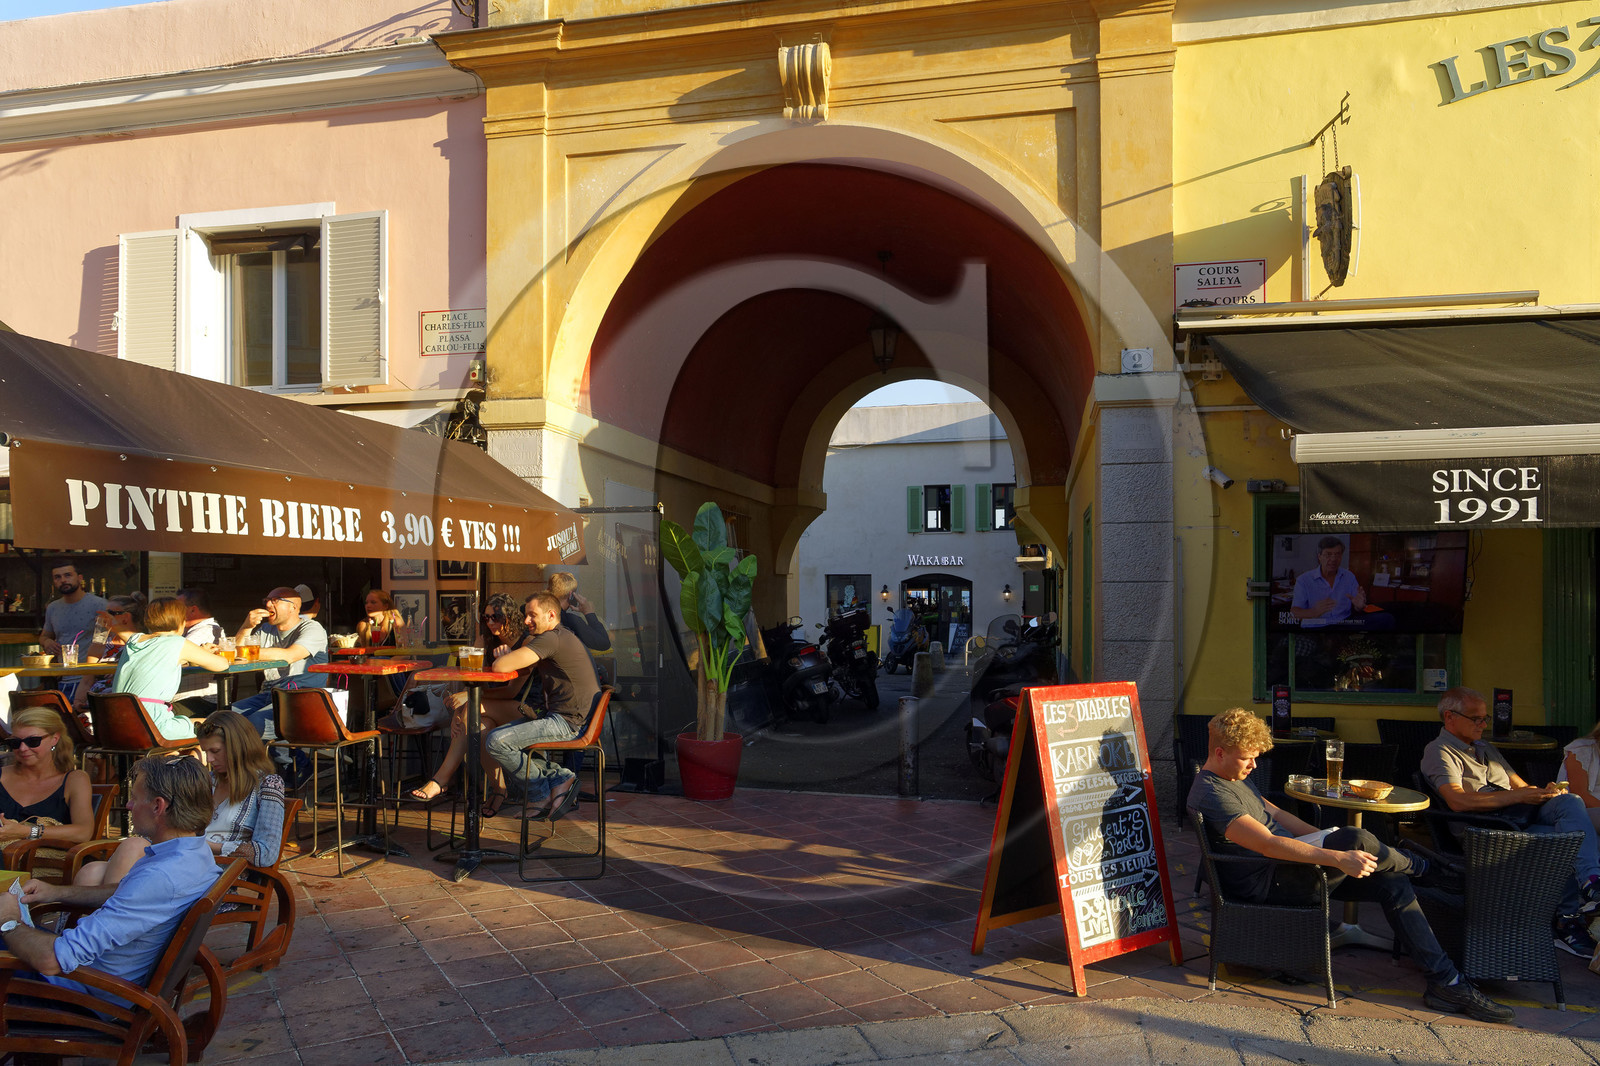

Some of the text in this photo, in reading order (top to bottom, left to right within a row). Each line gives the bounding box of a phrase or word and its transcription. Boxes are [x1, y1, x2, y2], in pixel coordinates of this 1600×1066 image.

[1438, 25, 1577, 104] LES
[1197, 276, 1242, 287] SALEYA
[1198, 265, 1240, 276] COURS
[1214, 295, 1256, 305] COURS
[424, 320, 485, 331] CHARLES-FÉLIX
[441, 313, 468, 321] PLACE
[425, 342, 485, 353] CARLOU-FELIS
[439, 334, 470, 342] PLASSA
[1432, 466, 1542, 493] SINCE
[1433, 496, 1544, 524] 1991
[259, 498, 364, 543] BIERE
[380, 510, 435, 550] 3,90
[440, 517, 455, 548] €
[458, 519, 498, 551] YES
[502, 523, 521, 553] !!!
[1042, 703, 1067, 725] LES
[1075, 696, 1131, 722] DIABLES
[1051, 738, 1137, 778] KARAOKE
[1058, 869, 1094, 888] TOUS
[1093, 863, 1118, 880] LES
[1120, 854, 1157, 873] JEUDIS
[1080, 916, 1111, 938] LIVE
